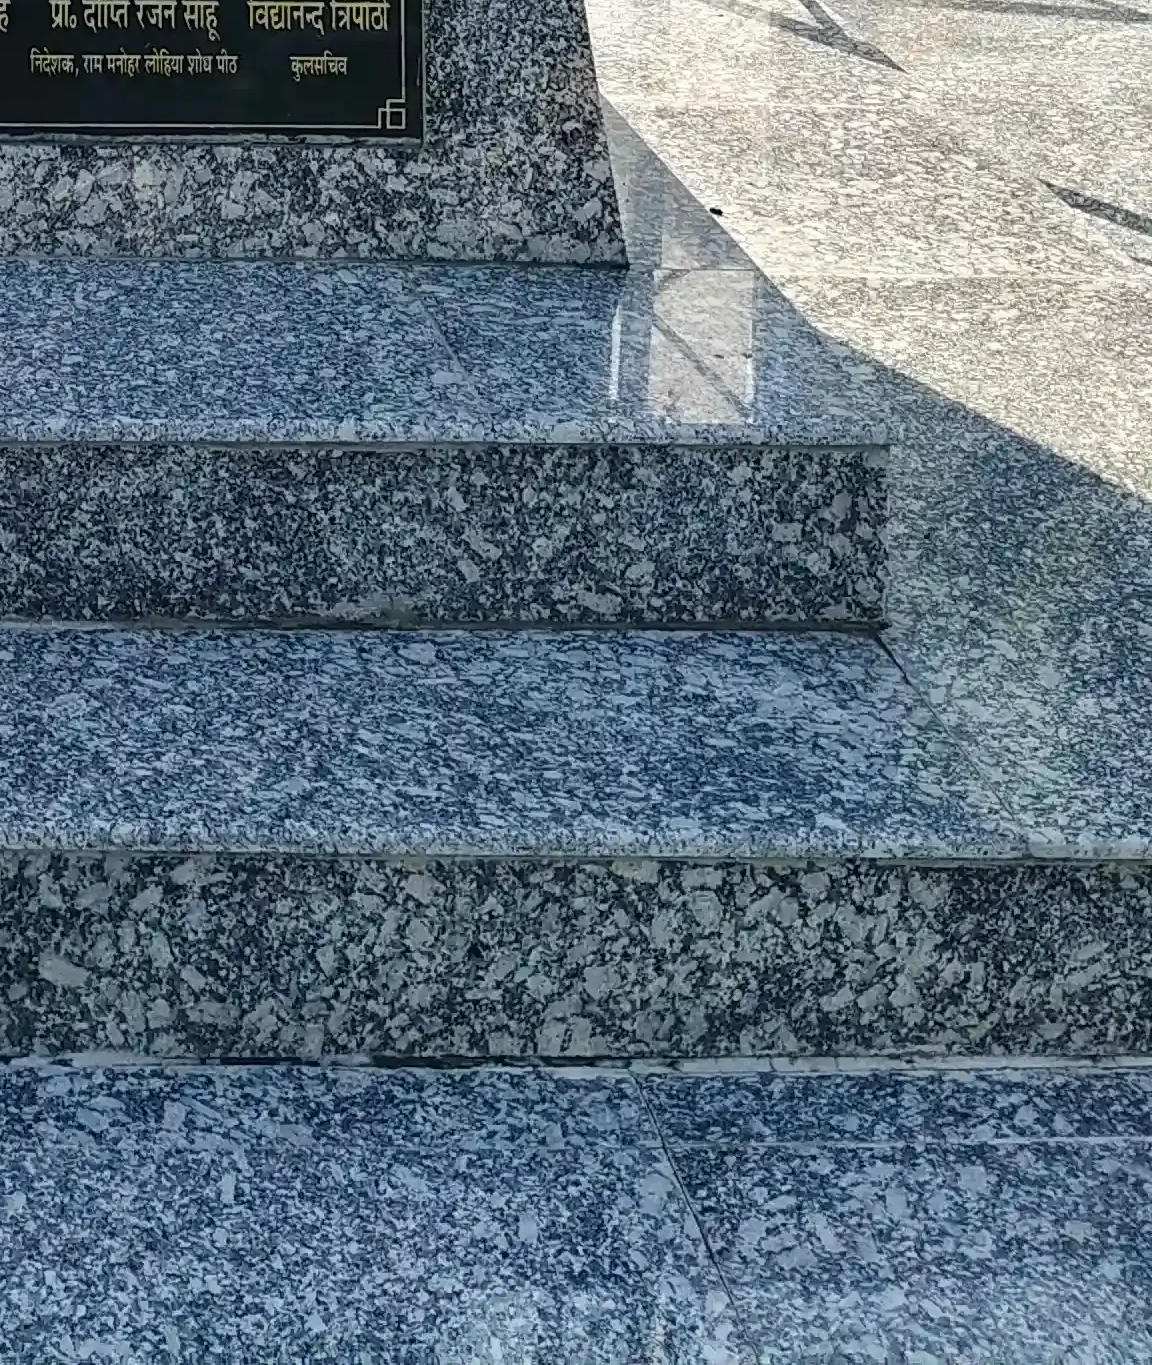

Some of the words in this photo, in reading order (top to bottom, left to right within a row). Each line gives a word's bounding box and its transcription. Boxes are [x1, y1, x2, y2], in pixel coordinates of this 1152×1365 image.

[182, 1, 219, 40] साहू
[31, 48, 78, 74] निदेशक,
[82, 55, 103, 72] राम
[106, 55, 141, 76] मनोहर
[144, 49, 183, 73] लोहिया
[188, 49, 212, 73] शोध
[216, 49, 238, 74] पीठ
[290, 51, 347, 81] कुलसचिव
